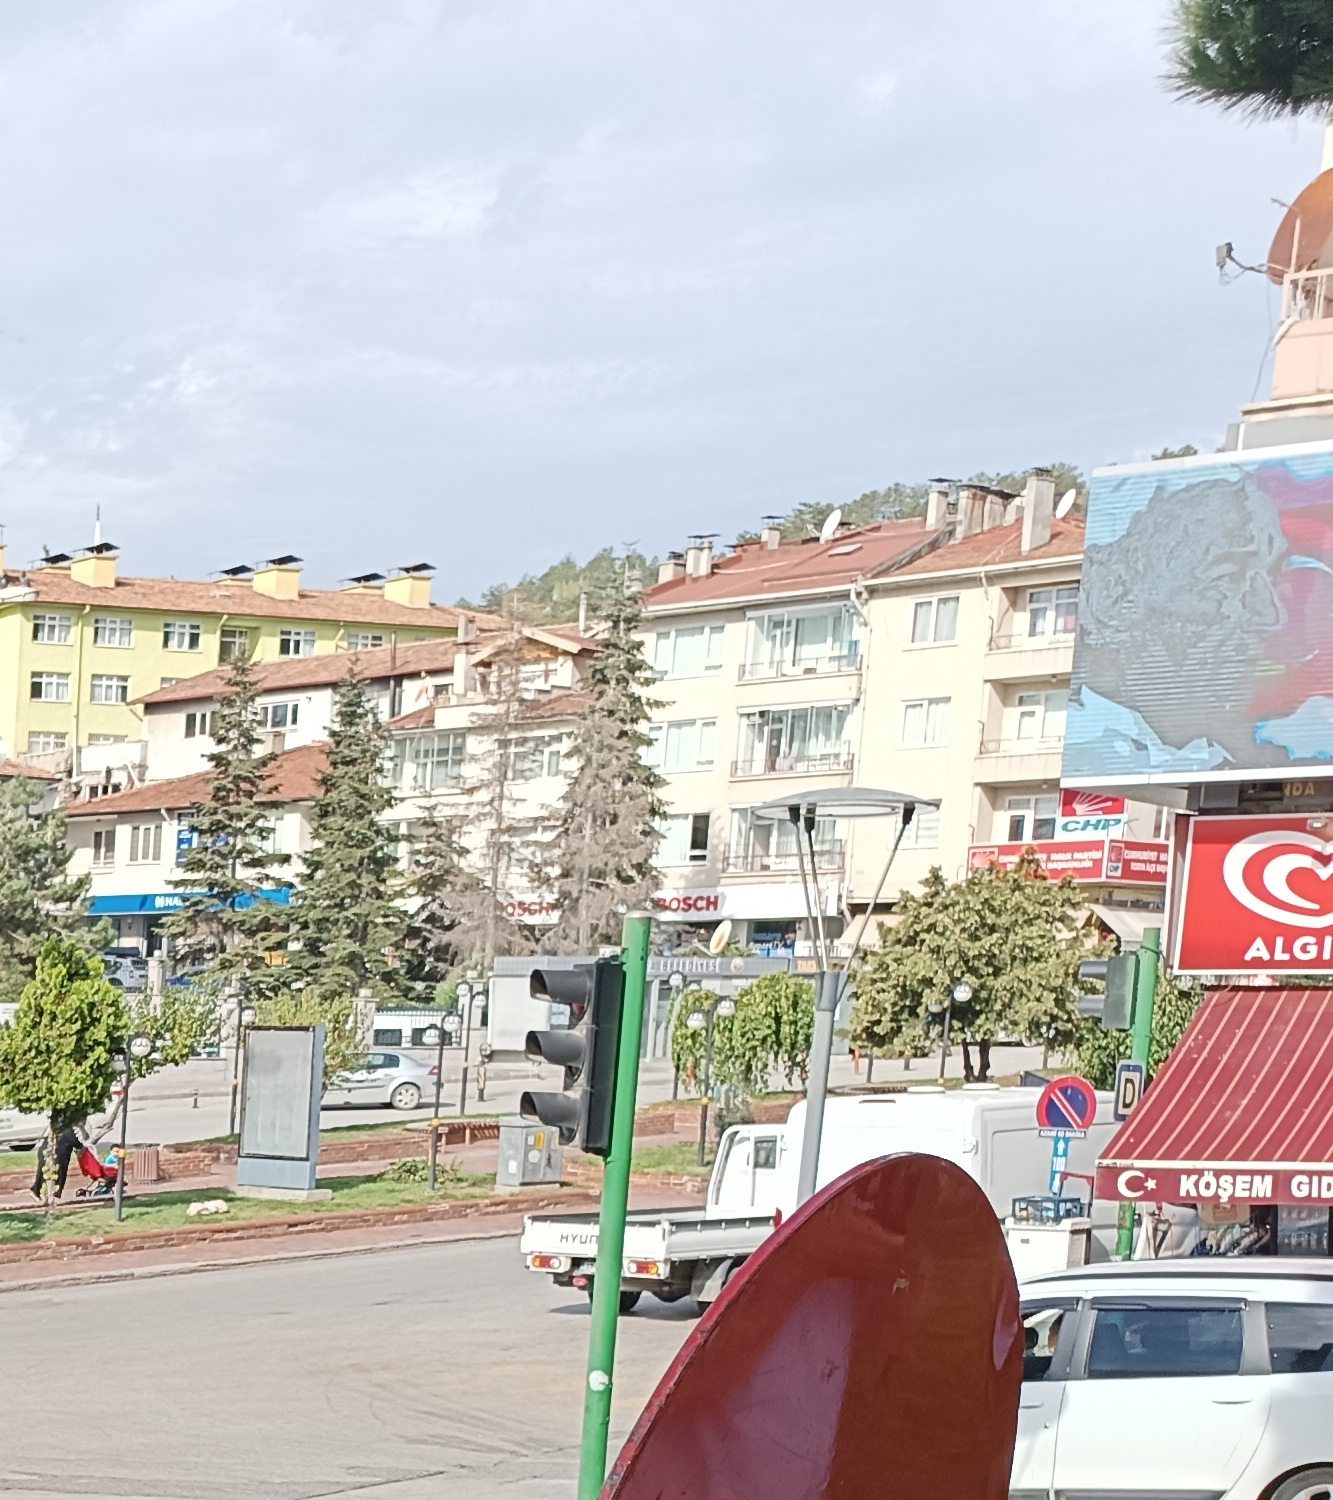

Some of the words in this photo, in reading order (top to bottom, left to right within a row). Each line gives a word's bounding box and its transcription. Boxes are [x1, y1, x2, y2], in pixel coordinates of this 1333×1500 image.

[1061, 818, 1122, 833] CHP
[503, 901, 552, 917] OSCH
[1244, 935, 1332, 961] ALGI
[1122, 1077, 1136, 1109] D
[1179, 1170, 1274, 1203] KÖŞEM
[559, 1233, 599, 1245] HYUN
